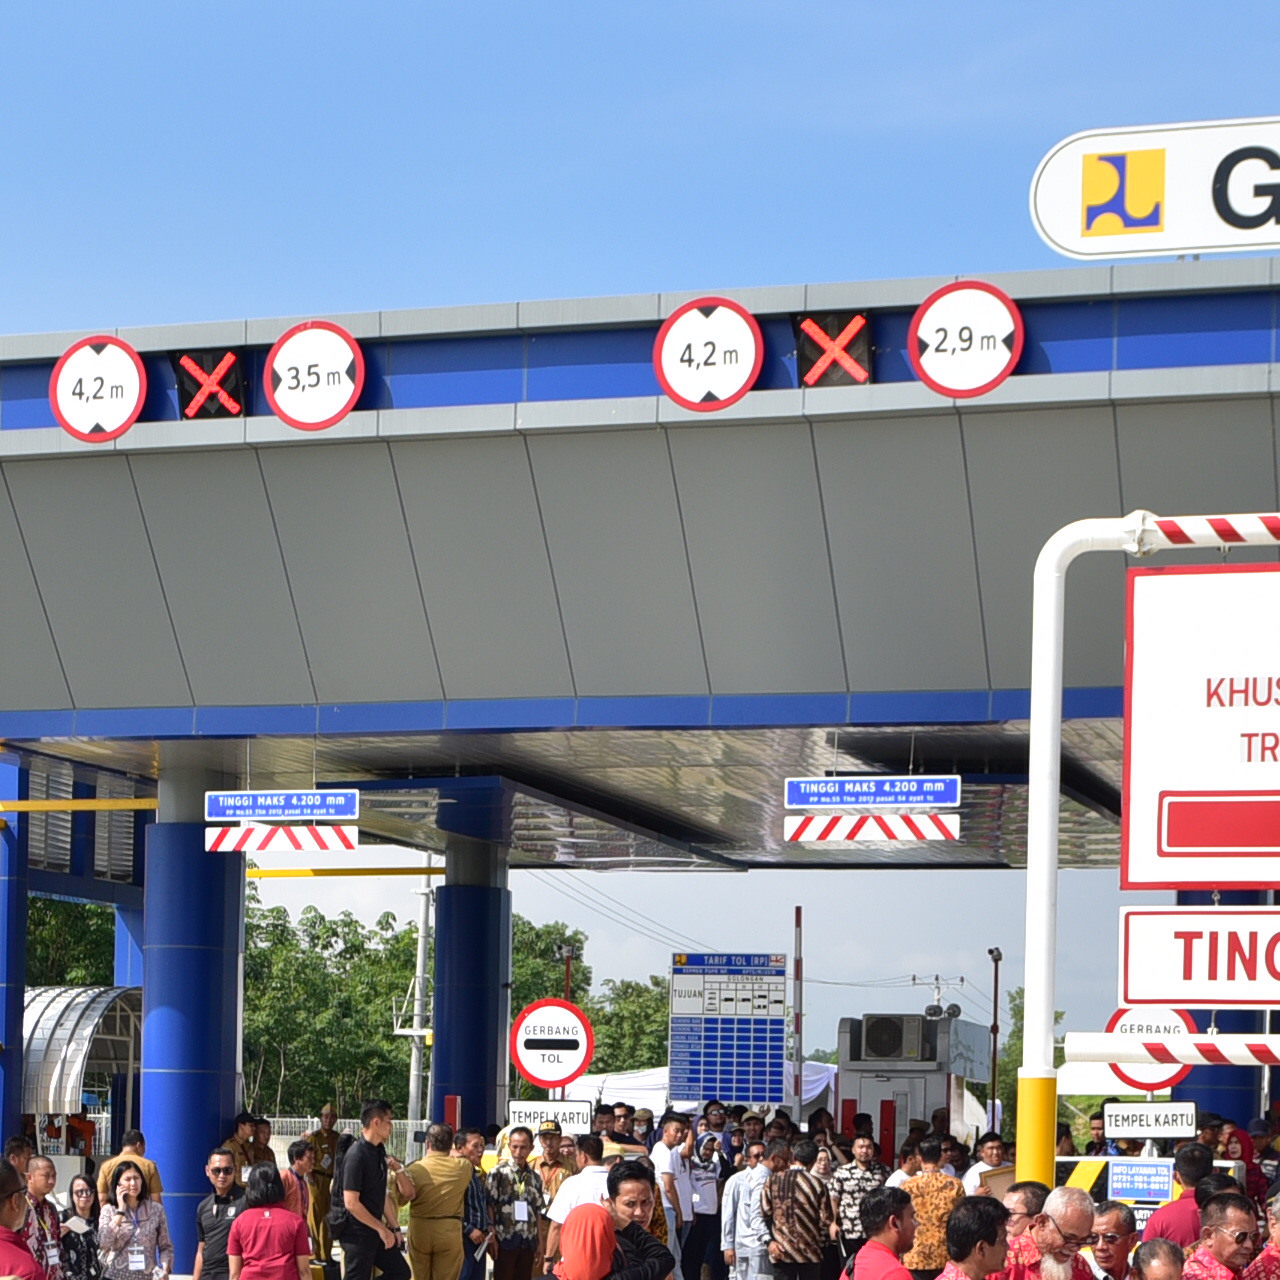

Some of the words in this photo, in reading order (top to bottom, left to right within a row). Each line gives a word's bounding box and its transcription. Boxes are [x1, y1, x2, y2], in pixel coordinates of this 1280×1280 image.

[934, 326, 973, 356] 2,9
[980, 334, 997, 351] m
[679, 341, 717, 370] 4,2
[723, 348, 739, 365] m
[287, 363, 321, 391] 3,5
[327, 369, 341, 387] m
[71, 376, 105, 403] 4,2
[110, 383, 124, 399] m
[800, 782, 839, 794] TINGGI
[844, 781, 876, 793] MAKS
[883, 781, 918, 793] 4.200
[923, 782, 945, 792] mm
[219, 796, 253, 806] TINGGI
[257, 795, 285, 806] MAKS
[291, 795, 321, 805] 4.200
[326, 796, 345, 805] mm
[704, 956, 727, 966] TARIF
[731, 956, 747, 966] TOL
[673, 989, 703, 999] TUJUAN
[524, 1025, 579, 1036] GERBANG
[540, 1053, 564, 1064] TOL
[553, 1111, 589, 1125] KARTU
[1107, 1114, 1152, 1127] TEMPEL
[1155, 1113, 1194, 1127] KARTU
